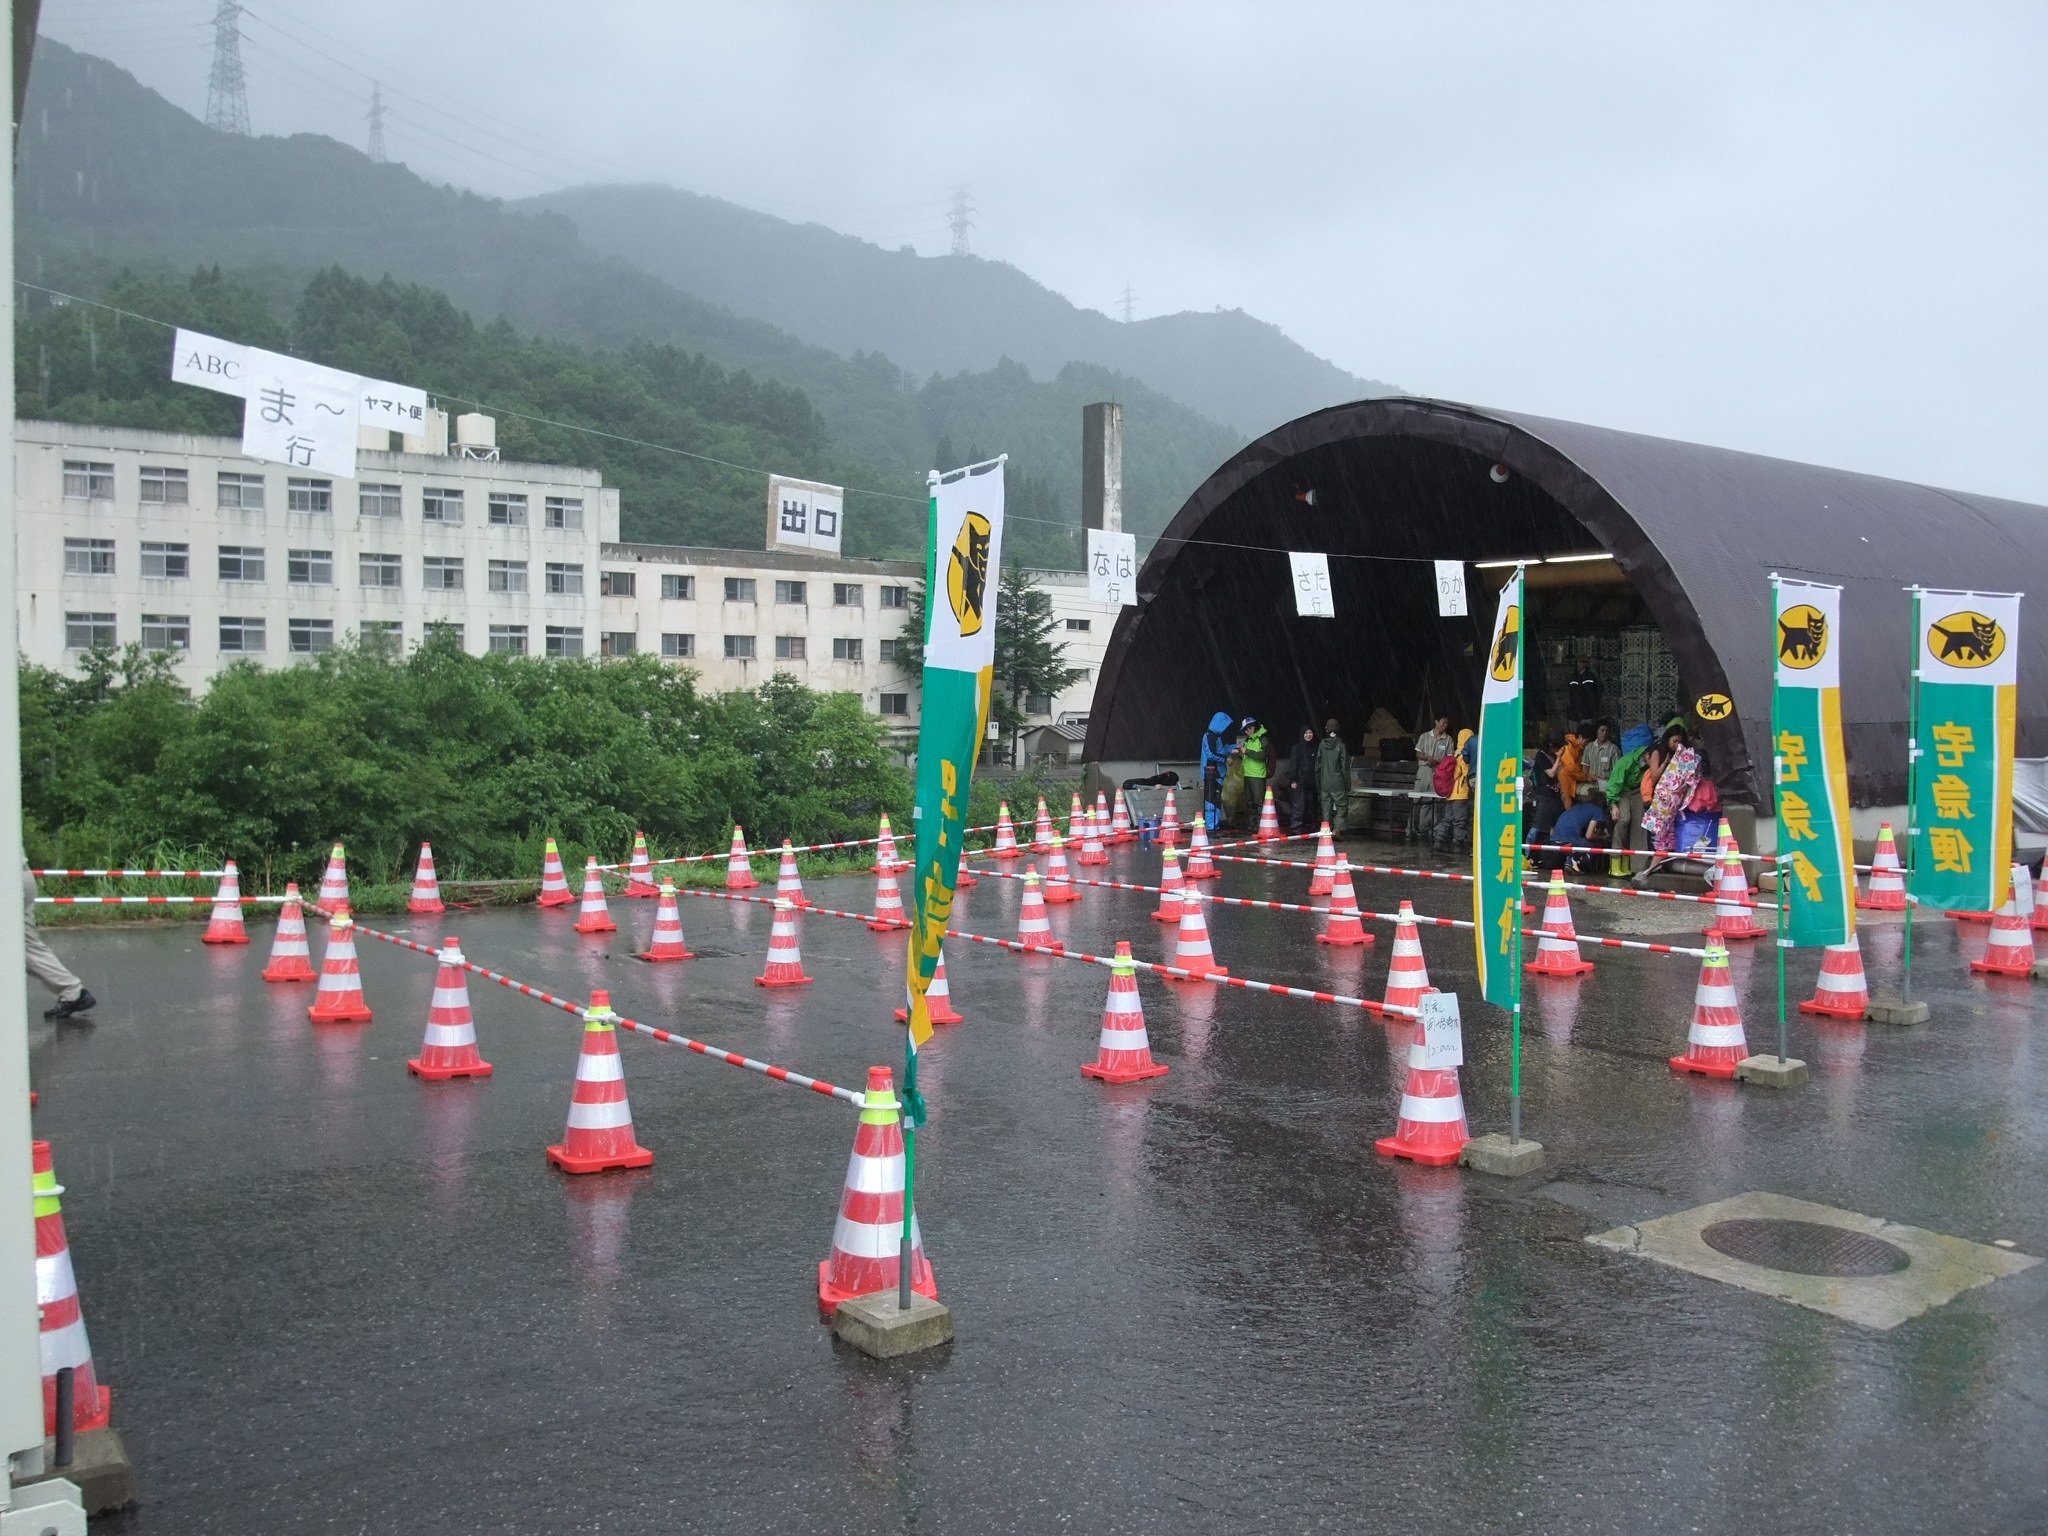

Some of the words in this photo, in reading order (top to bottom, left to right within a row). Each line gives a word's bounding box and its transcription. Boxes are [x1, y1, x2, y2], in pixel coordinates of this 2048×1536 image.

[186, 352, 240, 380] ABC
[364, 396, 423, 420] ヤマト便
[286, 435, 316, 466] 行
[781, 500, 837, 538] 出口
[1107, 582, 1120, 602] 行
[1311, 597, 1321, 613] 行
[1449, 600, 1457, 614] 行
